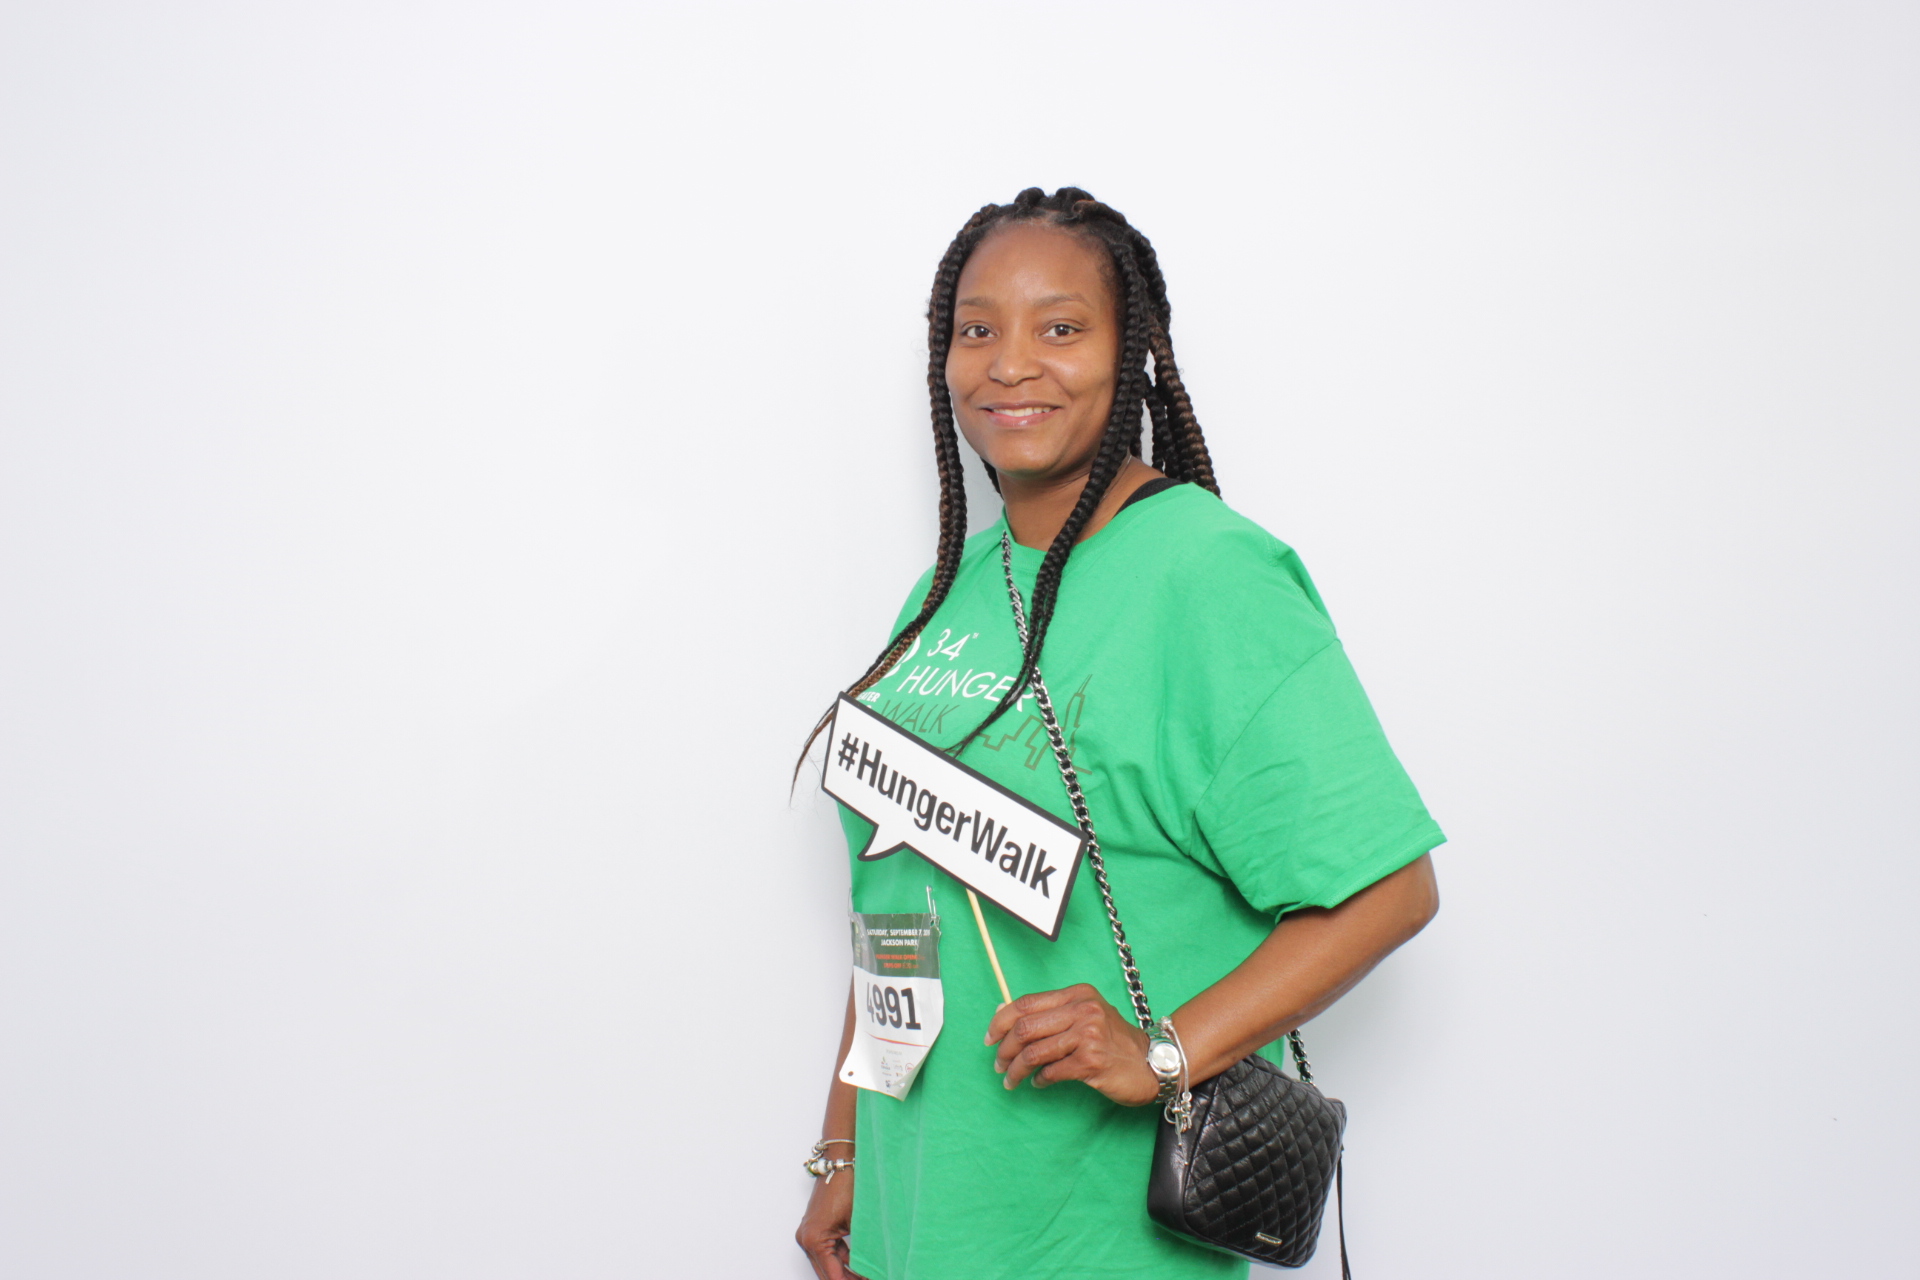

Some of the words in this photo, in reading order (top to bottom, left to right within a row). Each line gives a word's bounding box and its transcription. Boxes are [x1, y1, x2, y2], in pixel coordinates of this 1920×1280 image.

[896, 665, 1035, 712] HUNGER
[881, 699, 961, 734] WALK
[838, 732, 1057, 899] #HungerWalk
[880, 938, 904, 946] JACKSON
[904, 938, 918, 946] PARK
[890, 928, 918, 936] SEPTEMBER
[866, 982, 922, 1031] 4991
